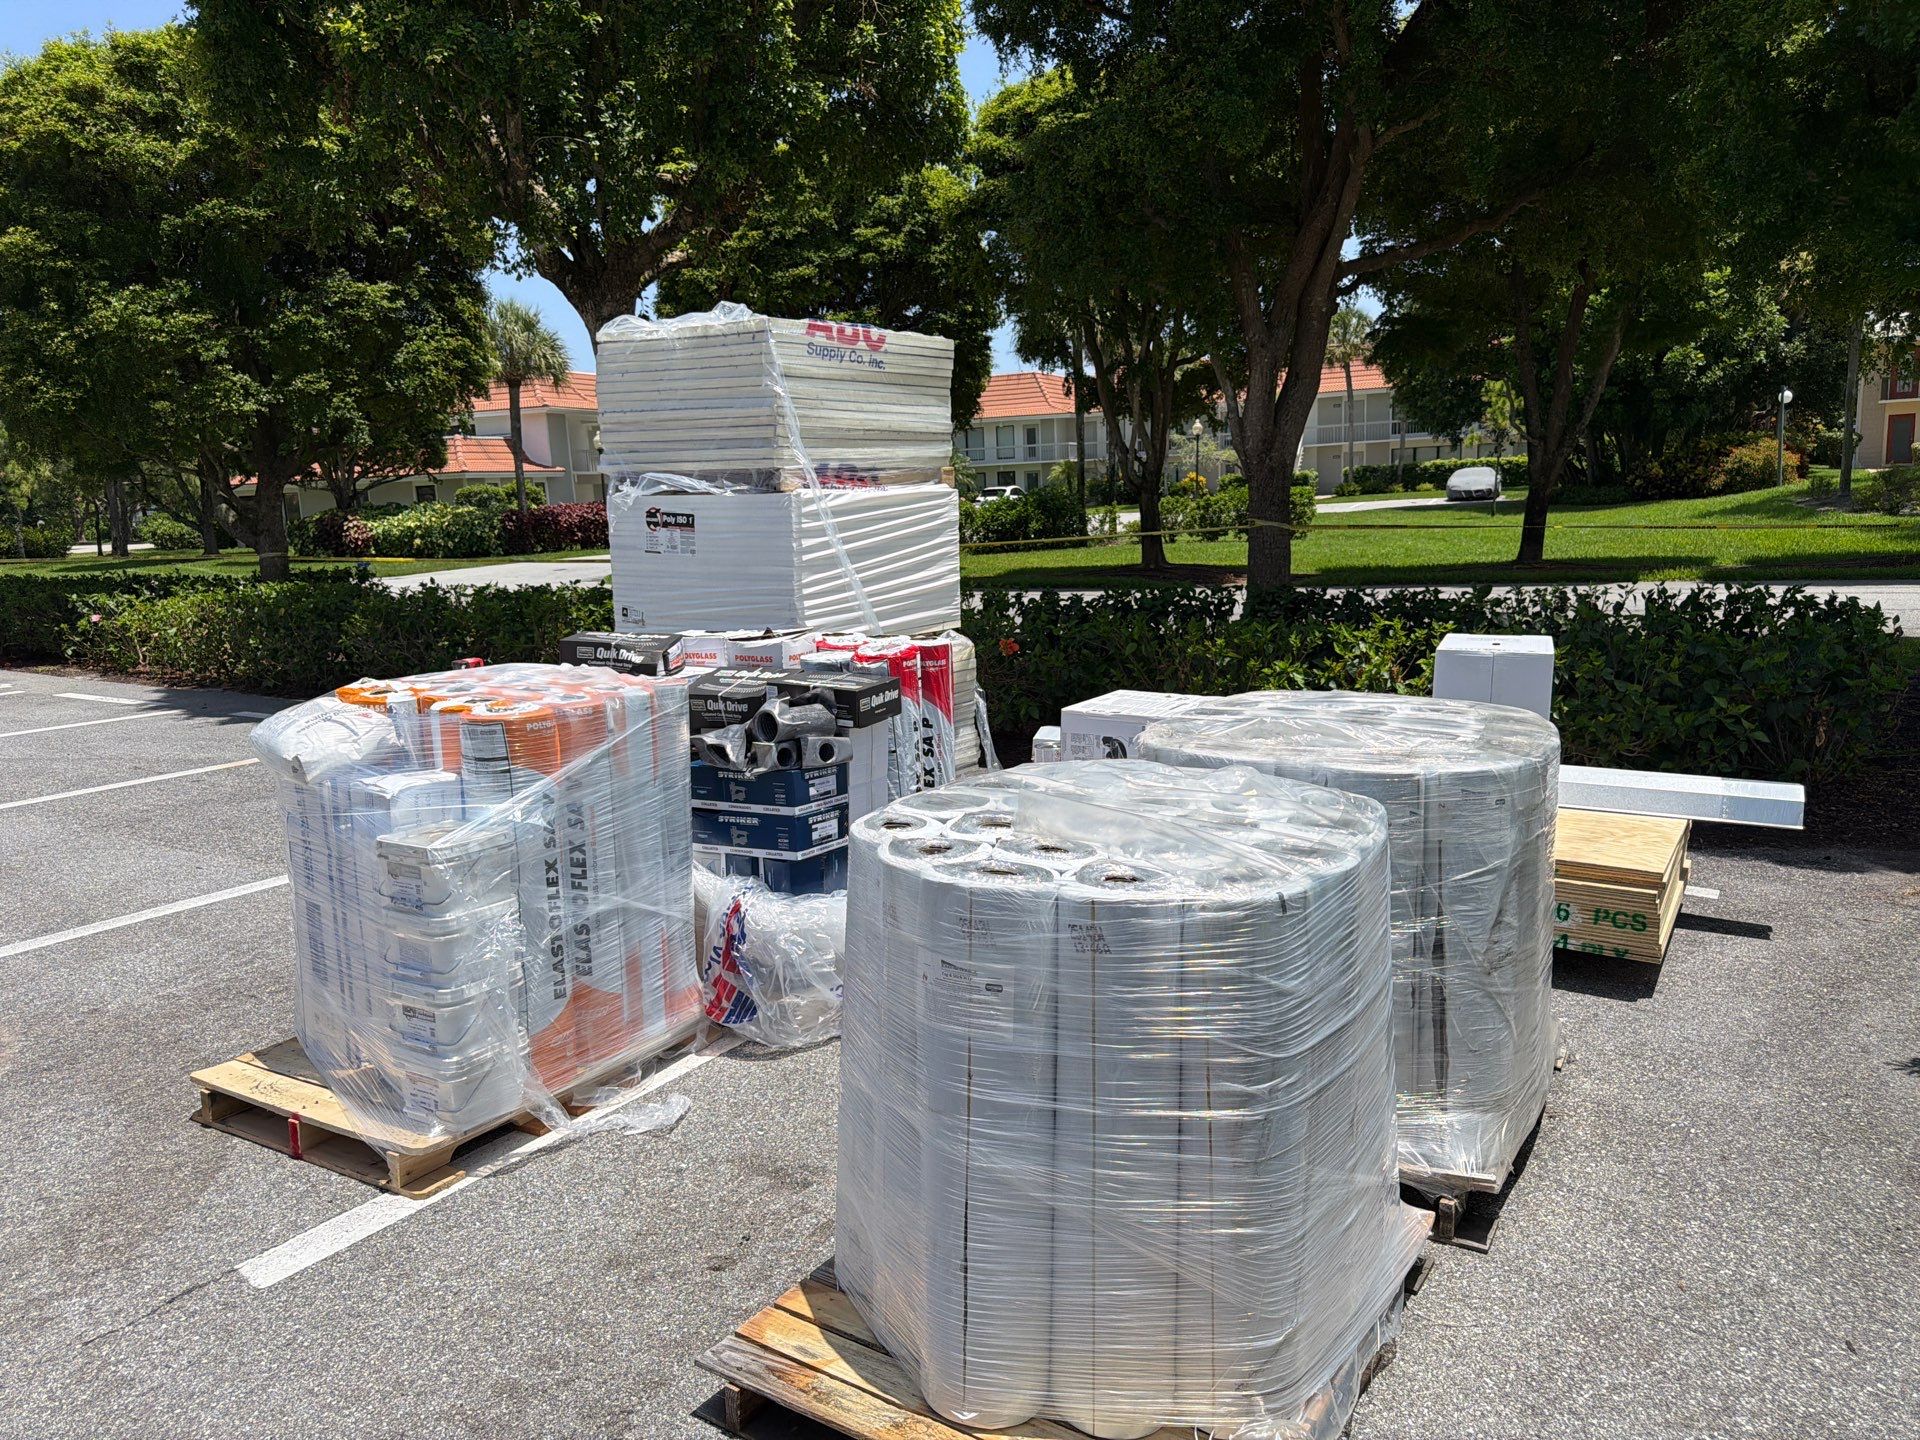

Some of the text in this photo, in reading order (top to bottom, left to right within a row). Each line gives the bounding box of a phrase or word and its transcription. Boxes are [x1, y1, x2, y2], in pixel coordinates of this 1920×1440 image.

[807, 342, 846, 363] Supply
[849, 350, 866, 365] Co.
[662, 514, 676, 525] Poly
[676, 515, 687, 523] ISO
[596, 647, 618, 659] Quik
[618, 648, 645, 663] Drive
[684, 652, 717, 660] OLYGLASS
[734, 654, 774, 663] POLYGLASS
[871, 692, 885, 707] Quik
[884, 689, 899, 702] Drive
[707, 699, 726, 711] Quik
[726, 701, 748, 712] Drive
[804, 766, 838, 780] STRIKER
[718, 815, 759, 825] STRIKER
[808, 810, 841, 824] STRIKER
[1593, 907, 1648, 932] PCS
[544, 857, 567, 1000] ELASTOFLEX
